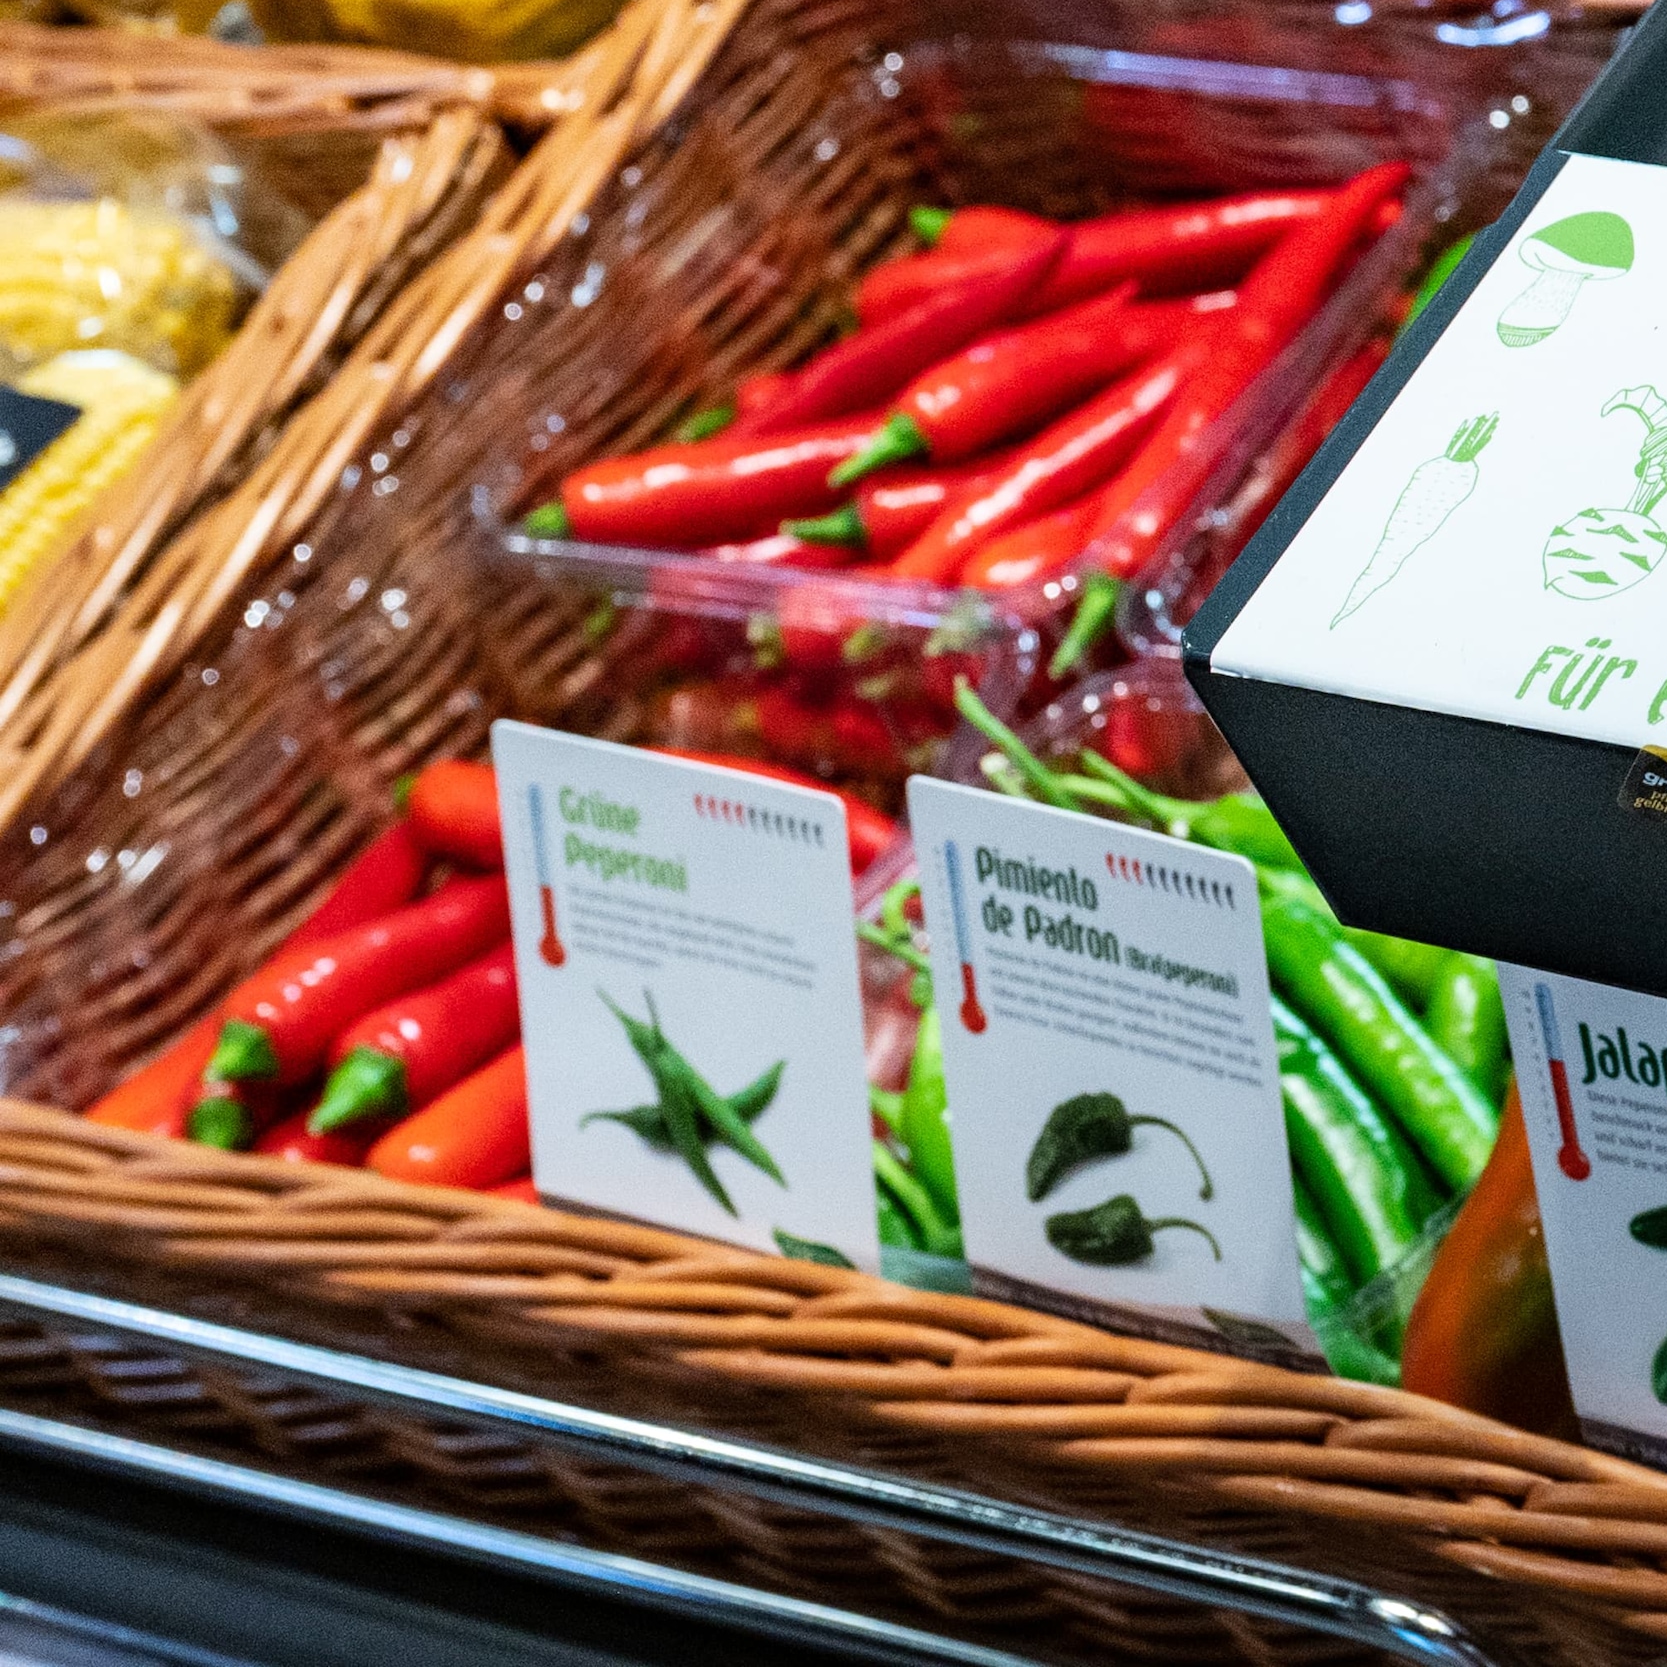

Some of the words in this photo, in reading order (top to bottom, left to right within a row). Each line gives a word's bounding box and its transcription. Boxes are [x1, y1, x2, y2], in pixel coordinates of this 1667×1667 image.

[1514, 637, 1638, 712] Für
[975, 845, 1099, 911] Pimiento
[981, 894, 1013, 937] de
[1023, 904, 1120, 965] Padron
